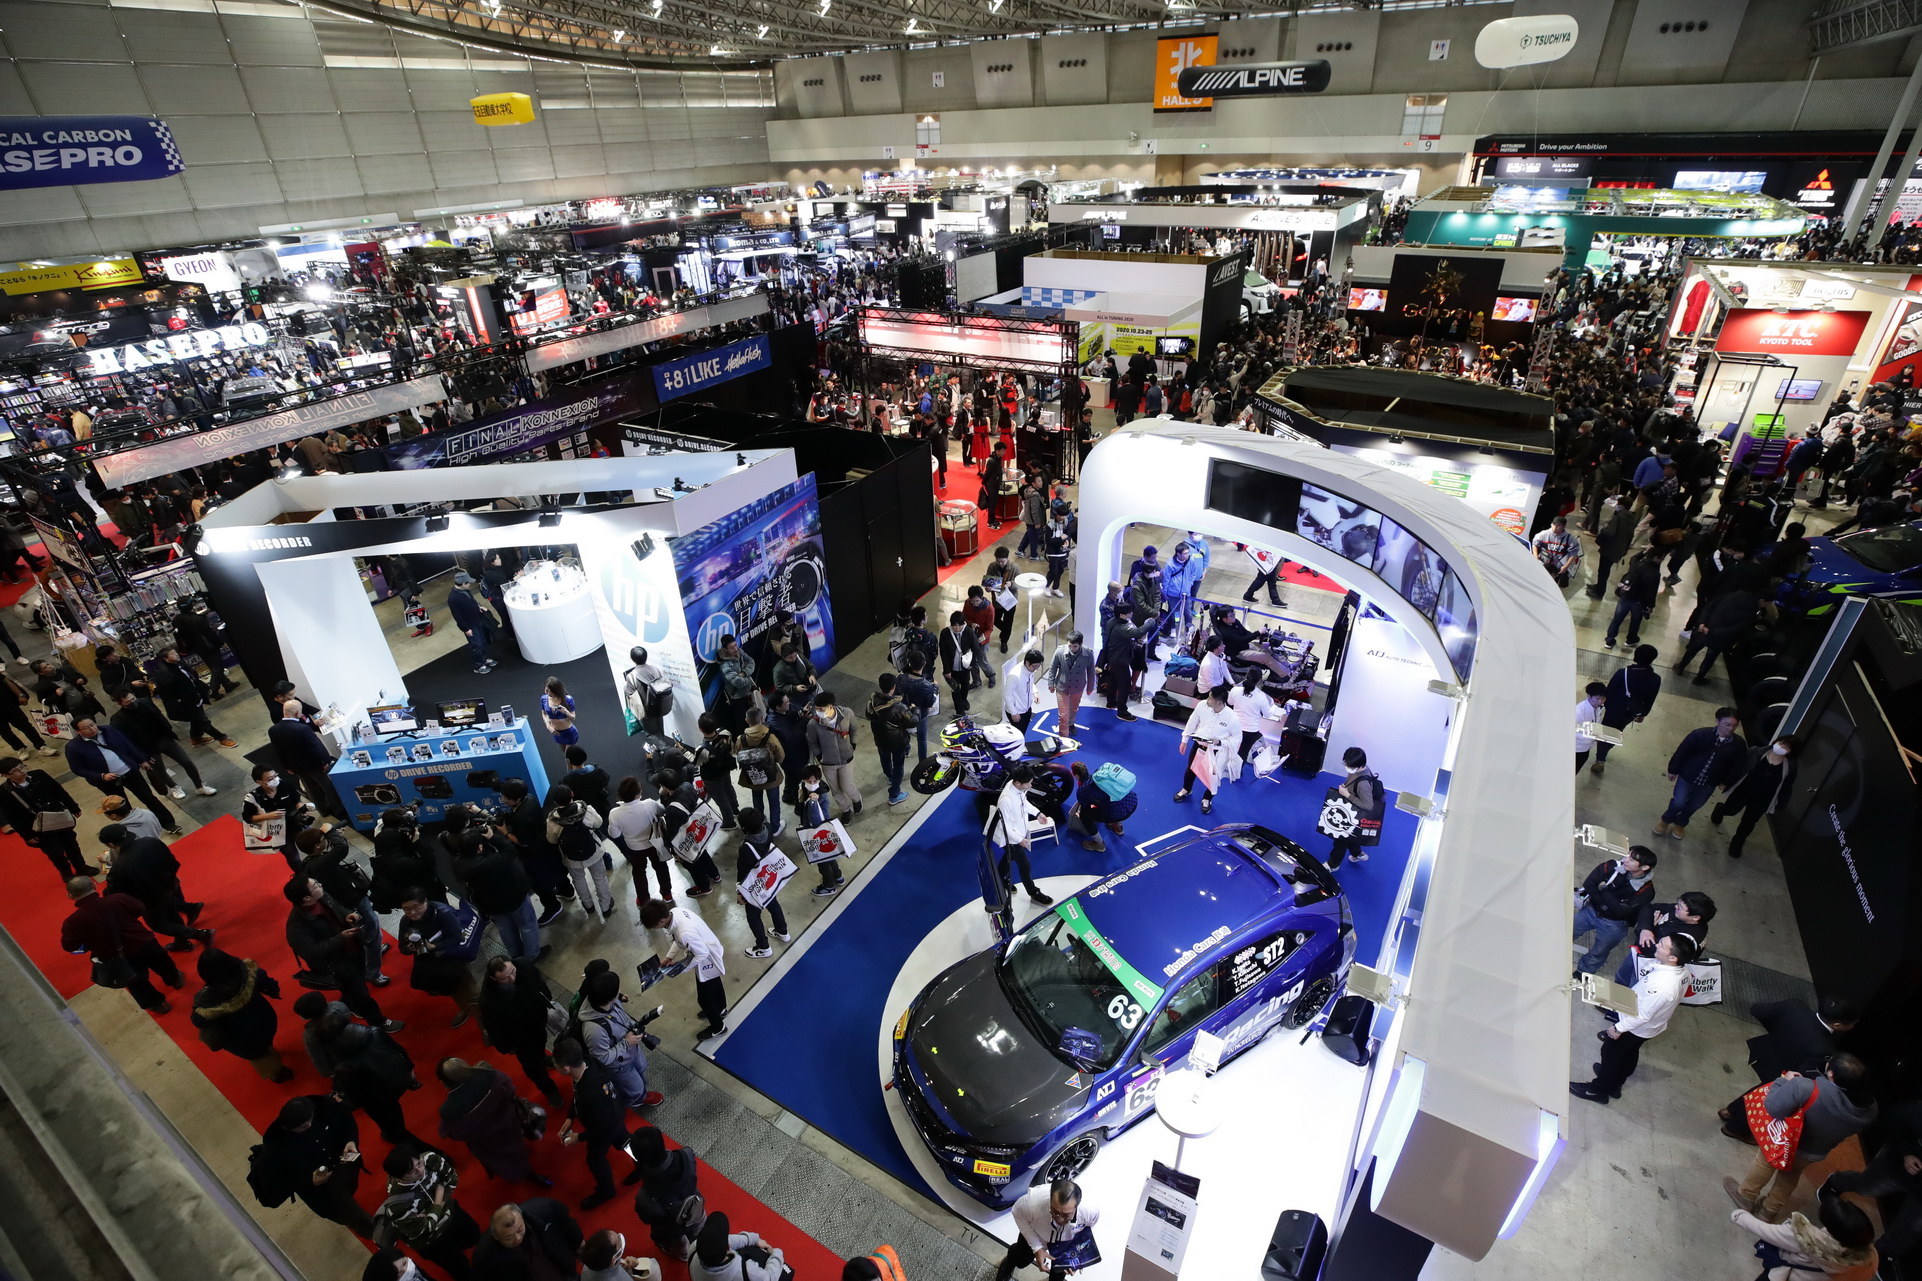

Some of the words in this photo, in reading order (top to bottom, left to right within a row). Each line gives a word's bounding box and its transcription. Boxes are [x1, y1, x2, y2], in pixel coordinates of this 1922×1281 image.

[1535, 32, 1571, 46] TSUCHIYA
[1222, 67, 1306, 89] ALPINE
[42, 128, 133, 144] CARBON
[920, 149, 926, 157] 9
[1424, 140, 1432, 151] 9
[1539, 143, 1558, 151] Drive
[1575, 143, 1608, 151] Ambition
[0, 145, 143, 173] SEPRO
[174, 258, 217, 276] GYEON
[1761, 319, 1821, 338] KTC
[1759, 338, 1788, 346] KYOTO
[1791, 338, 1813, 346] TOOL
[1893, 345, 1918, 361] GOODS
[451, 422, 518, 454] FINAL
[521, 396, 598, 432] KONNEXION
[450, 451, 478, 466] High
[481, 438, 526, 456] Quality
[740, 634, 750, 645] HP
[749, 620, 769, 640] DRIVE
[399, 766, 427, 778] DRIVE
[427, 761, 473, 775] RECORDER
[1828, 803, 1842, 833] Create
[1837, 830, 1847, 848] the
[1126, 860, 1159, 877] Honda
[1841, 847, 1860, 884] glorious
[1106, 874, 1129, 888] Cars
[1855, 882, 1876, 924] moment
[1163, 949, 1198, 977] Honda
[1192, 935, 1215, 953] Cars
[1263, 936, 1285, 965] ST2
[702, 963, 714, 971] ATJ
[1693, 985, 1715, 993] Walk
[1107, 994, 1143, 1030] 63
[1096, 1080, 1116, 1102] ATJ
[952, 1156, 964, 1164] ATJ
[976, 1162, 1008, 1176] PIRELLI
